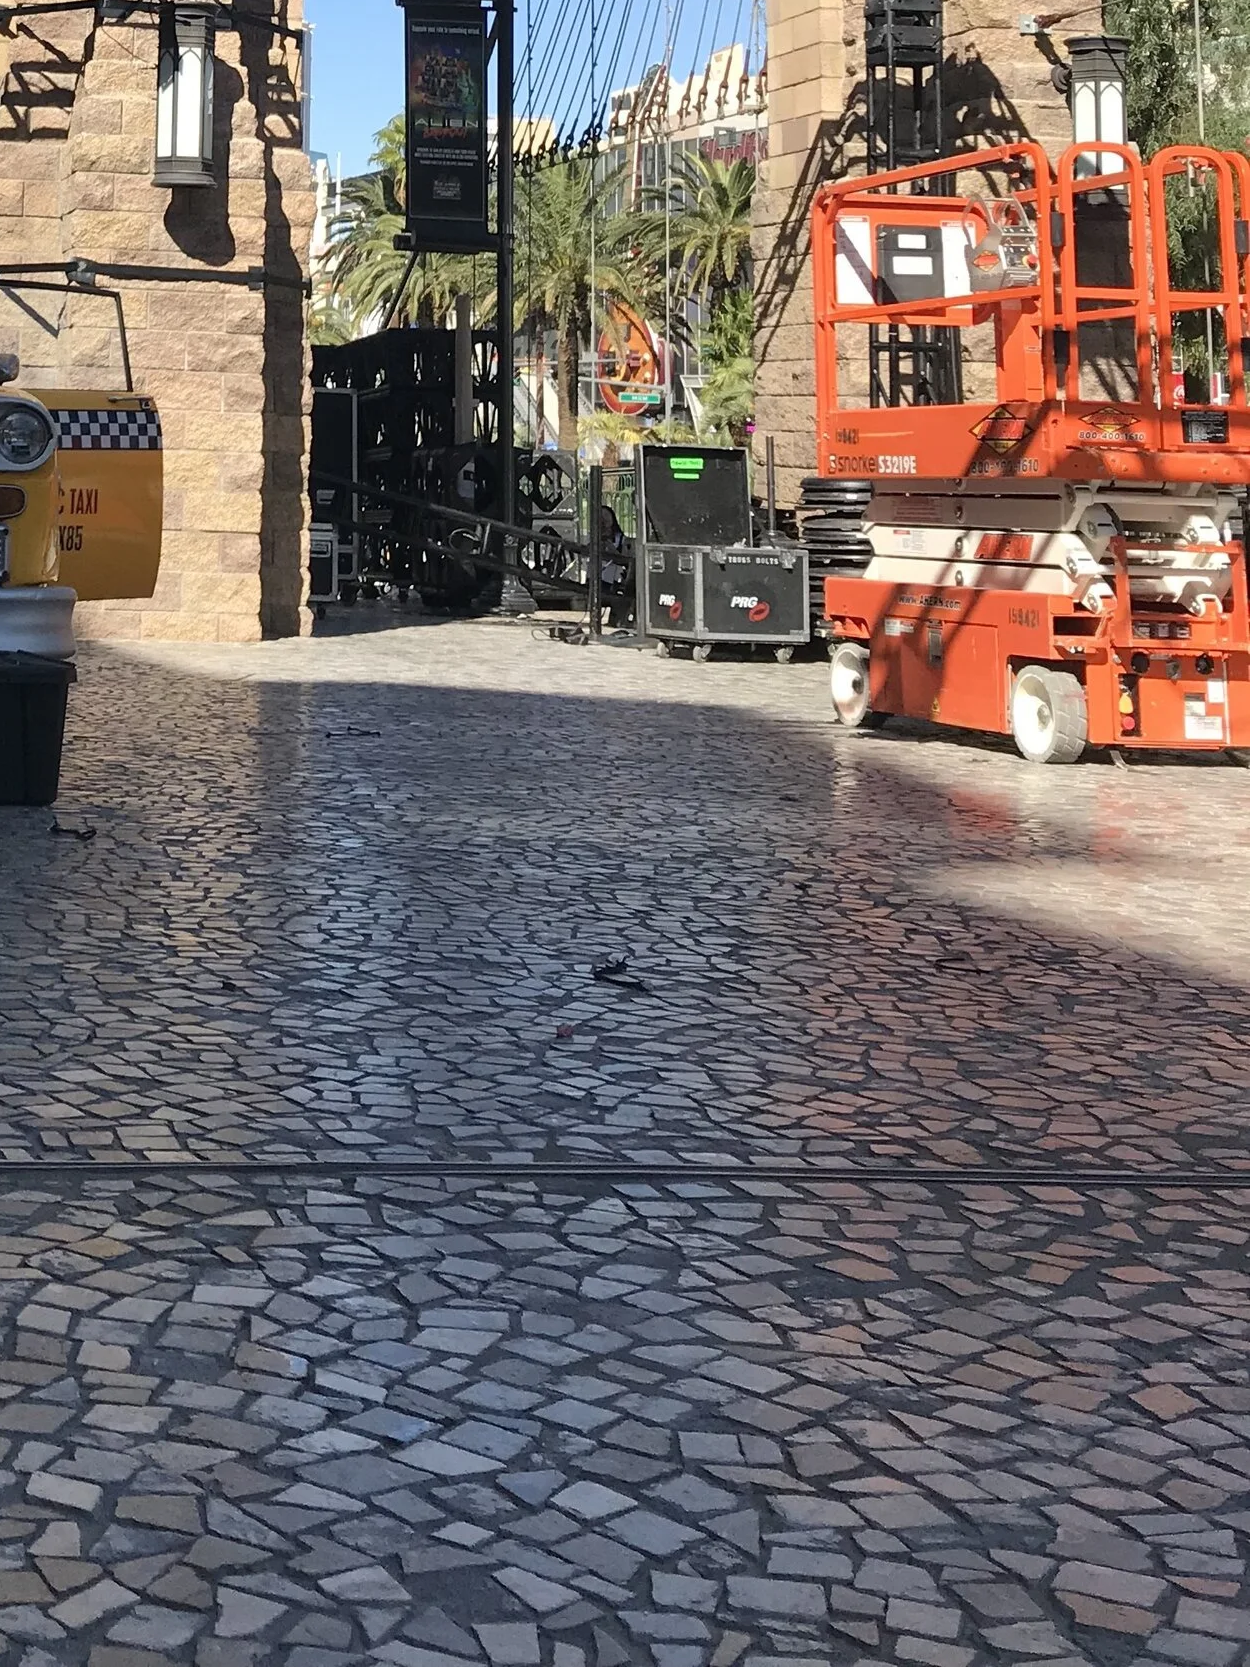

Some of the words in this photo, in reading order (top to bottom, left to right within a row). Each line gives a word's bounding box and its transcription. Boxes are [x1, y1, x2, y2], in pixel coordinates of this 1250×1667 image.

[414, 118, 479, 128] ALIEN
[878, 455, 917, 474] S3219E
[70, 488, 98, 515] TAXI
[58, 525, 83, 551] X85
[728, 556, 751, 564] TRUSS
[755, 557, 779, 565] BOLTS
[659, 594, 676, 606] PRG
[730, 596, 759, 608] PRG
